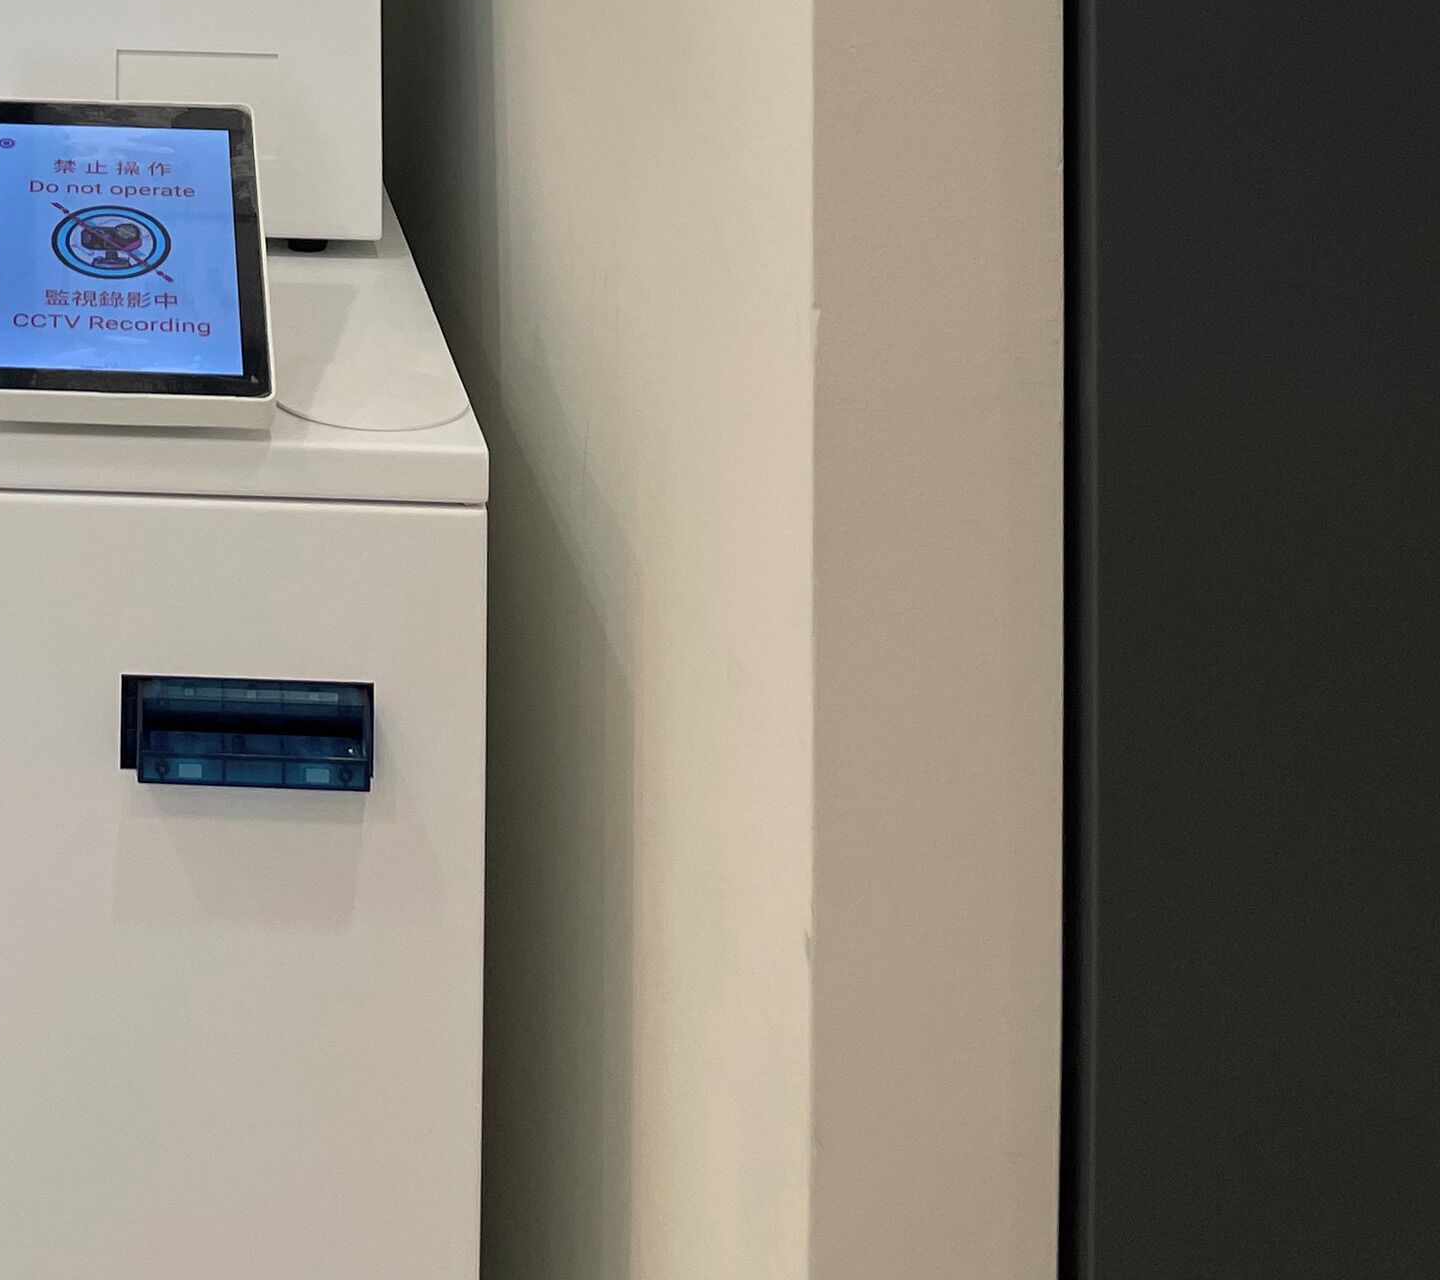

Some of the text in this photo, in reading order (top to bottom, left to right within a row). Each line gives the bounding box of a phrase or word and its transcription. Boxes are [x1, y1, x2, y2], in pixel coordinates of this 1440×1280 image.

[53, 158, 173, 177] 禁止操作
[29, 179, 196, 199] Do not operate
[44, 289, 179, 309] 監視錄影中
[13, 313, 212, 337] CCTV Recording
